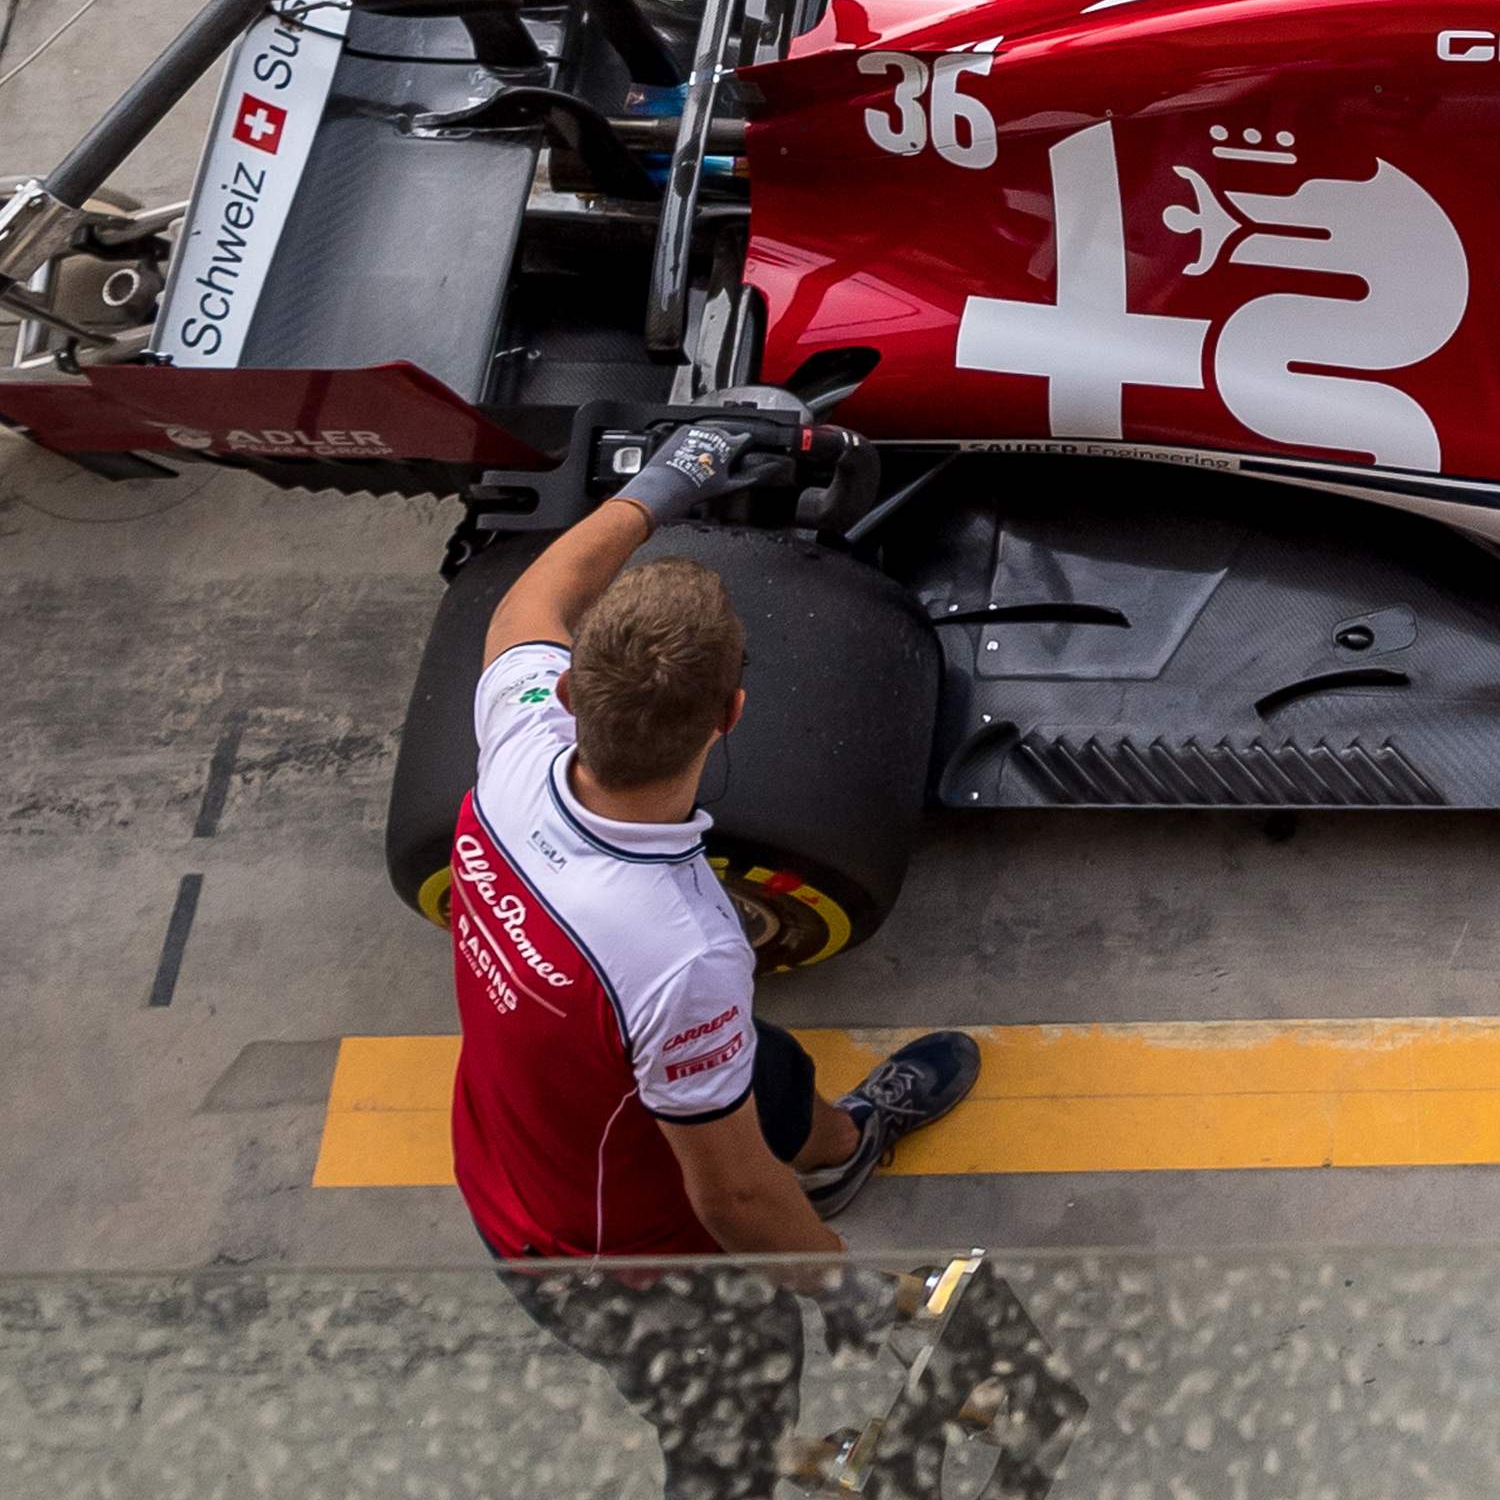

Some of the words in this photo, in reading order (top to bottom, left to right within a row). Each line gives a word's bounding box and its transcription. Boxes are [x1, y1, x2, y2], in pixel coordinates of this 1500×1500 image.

[857, 51, 998, 170] 36
[180, 161, 266, 356] Schweiz
[226, 430, 385, 447] ADLER
[456, 834, 498, 906] Alfa
[492, 894, 574, 987] Romeo
[457, 913, 518, 1011] RACING
[662, 1005, 739, 1052] CARRERA
[664, 1030, 744, 1084] PIRELLI
